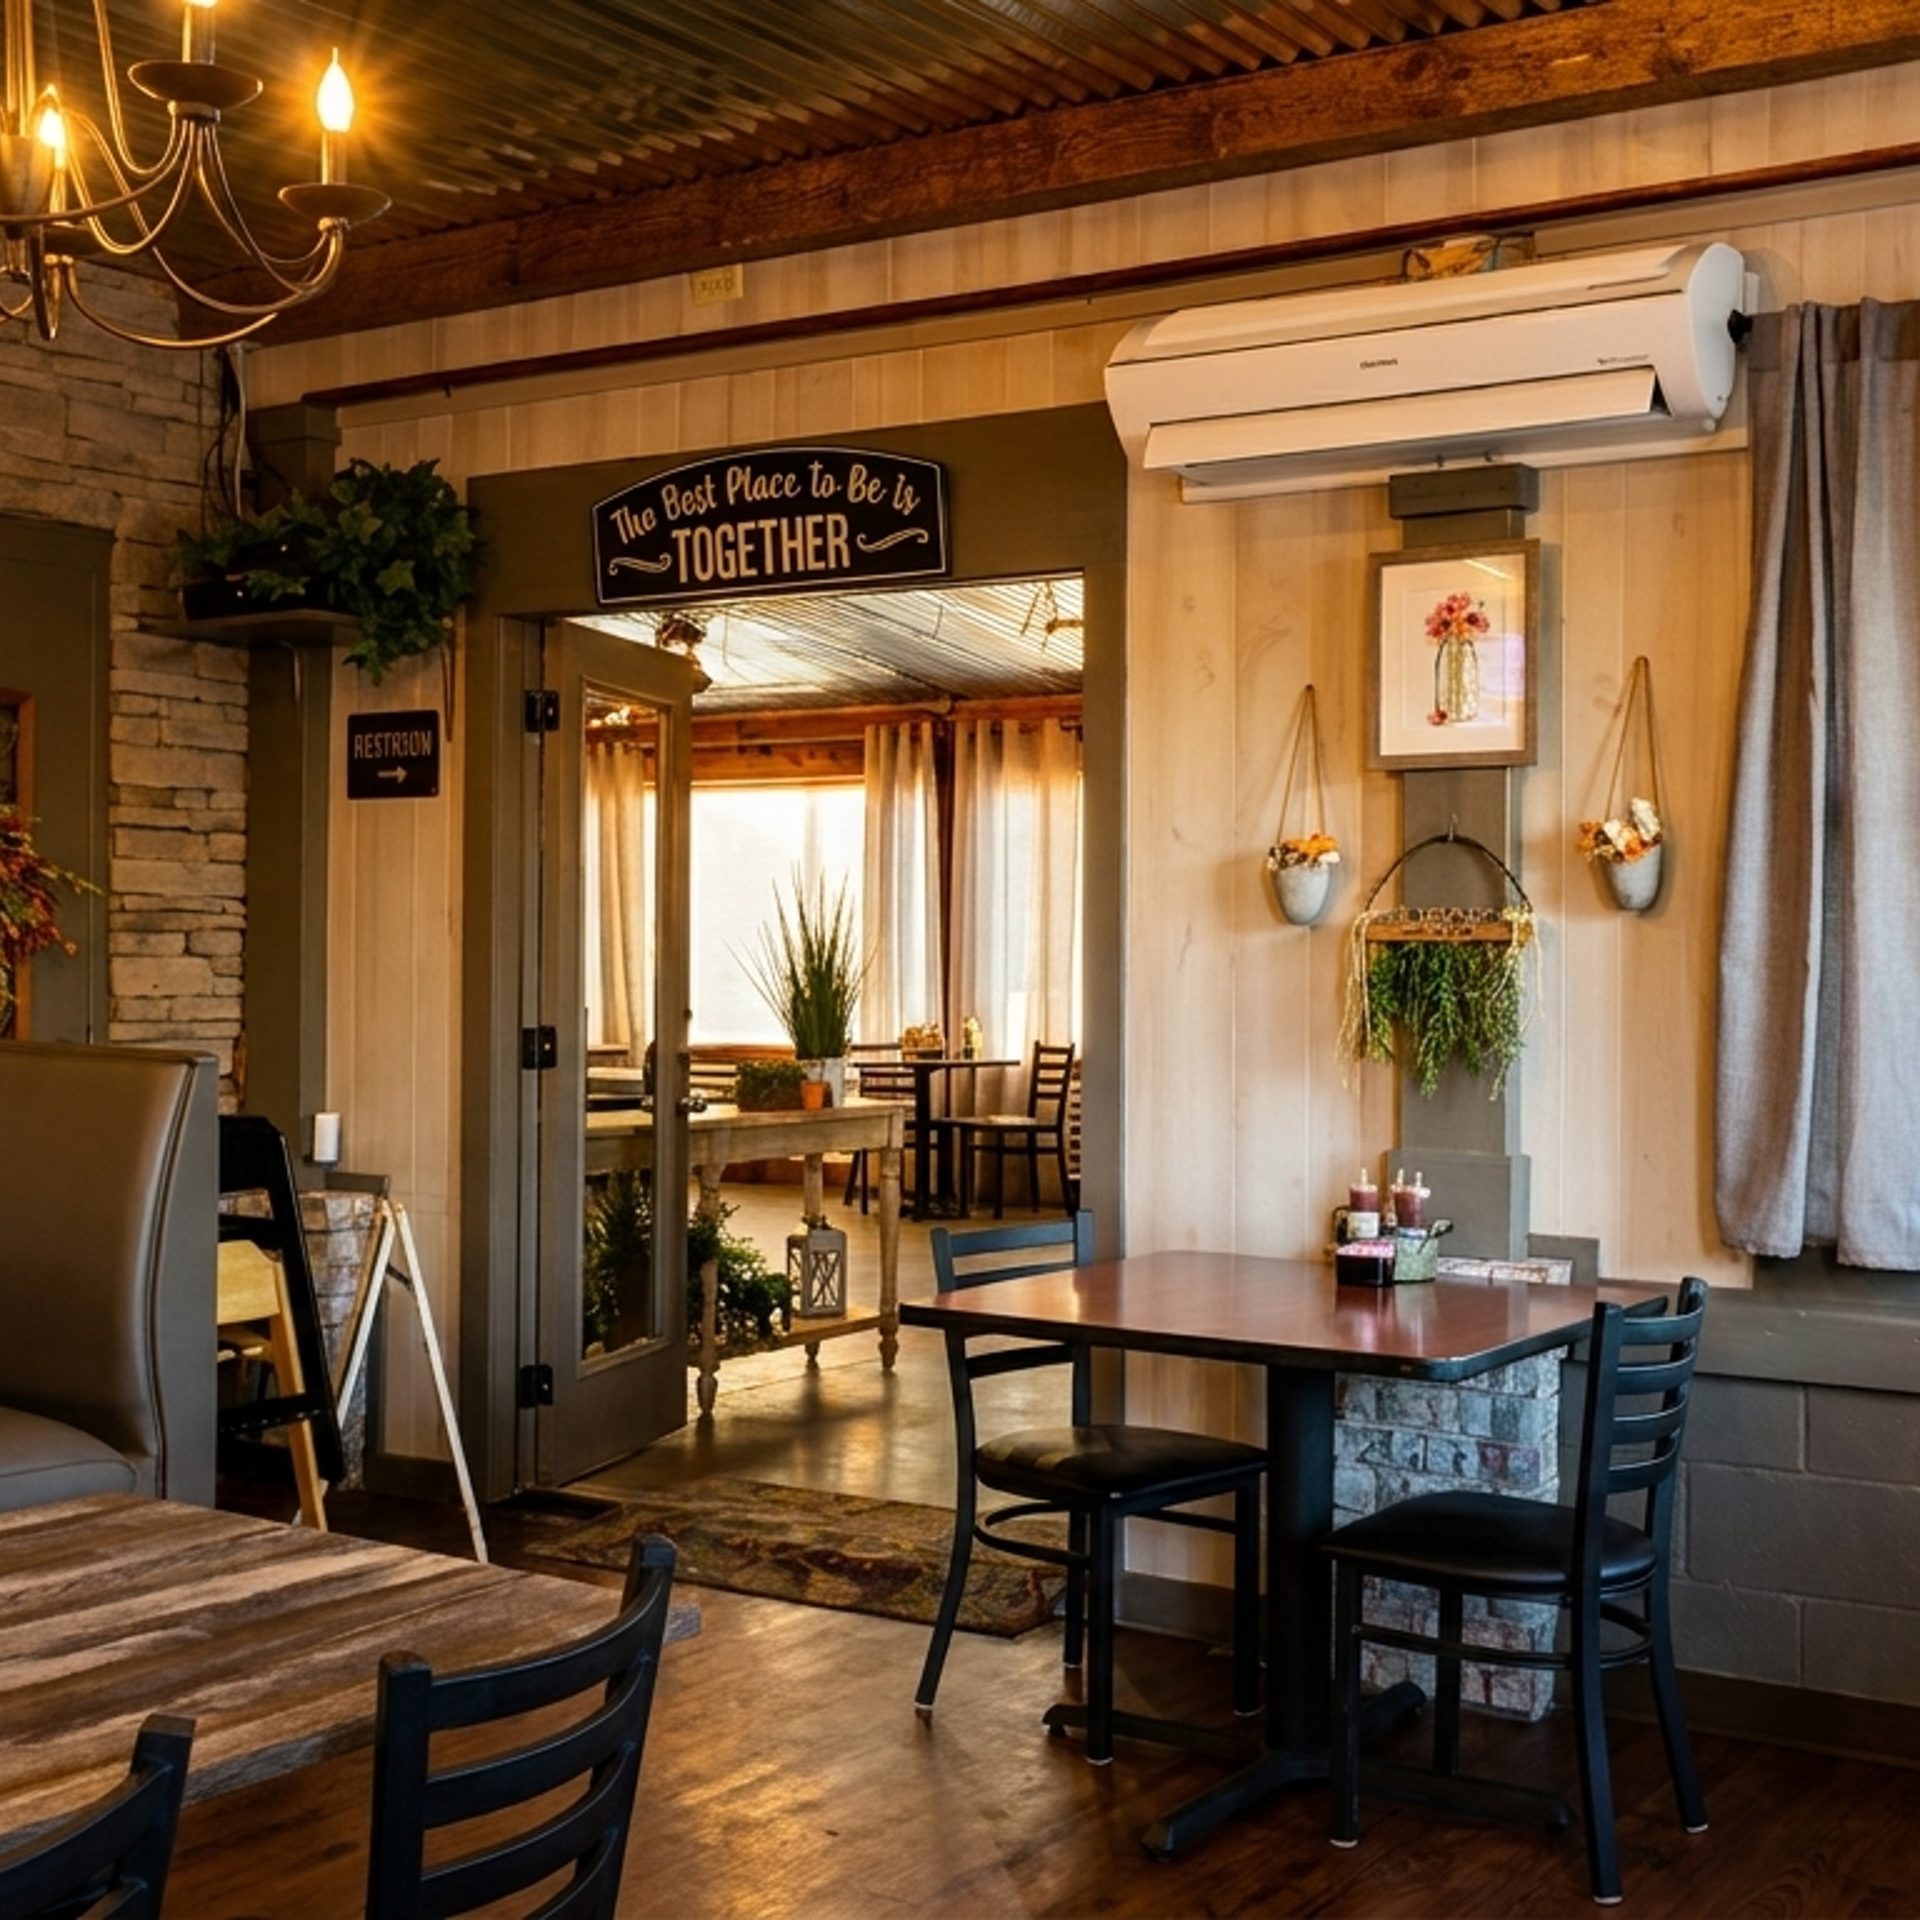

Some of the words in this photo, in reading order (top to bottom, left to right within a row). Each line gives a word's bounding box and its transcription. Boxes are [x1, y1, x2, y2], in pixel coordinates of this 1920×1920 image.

[610, 504, 656, 544] The
[661, 476, 716, 520] Best
[727, 466, 800, 505] Place
[808, 460, 841, 498] to
[847, 464, 887, 503] Be
[671, 513, 851, 583] TOGETHER
